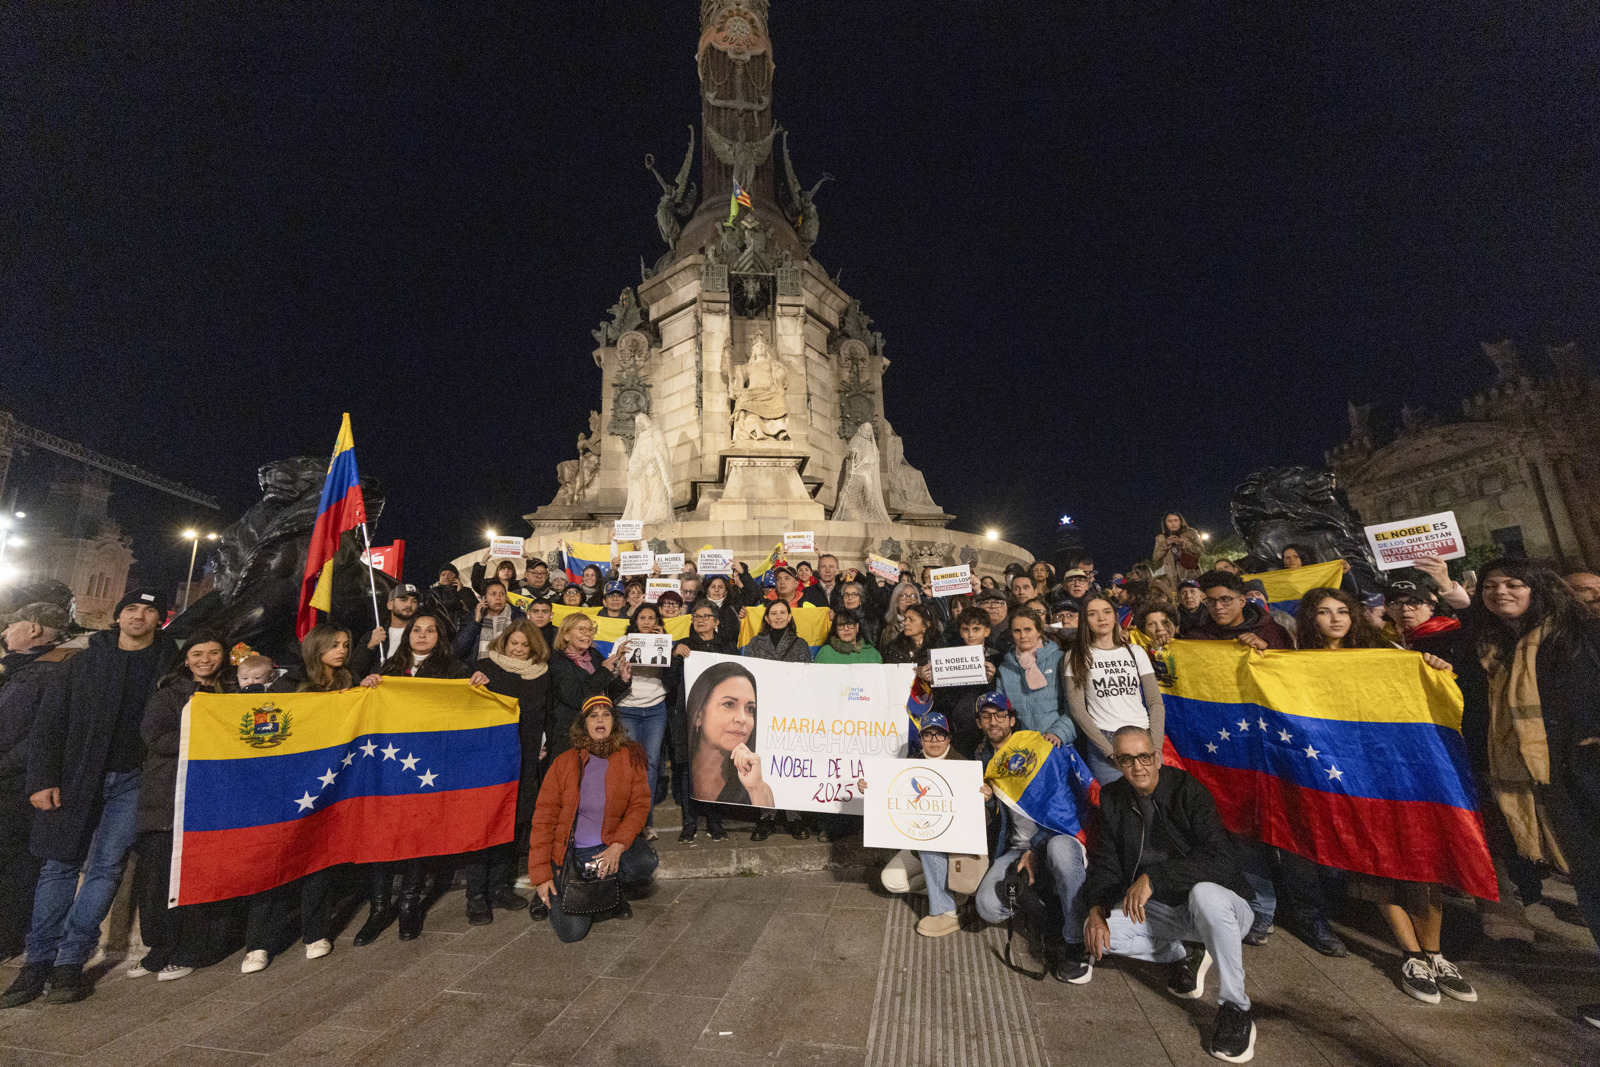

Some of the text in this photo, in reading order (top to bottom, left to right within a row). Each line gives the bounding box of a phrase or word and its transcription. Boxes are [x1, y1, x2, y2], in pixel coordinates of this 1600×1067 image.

[1391, 526, 1430, 538] NOBEL
[1433, 522, 1447, 531] ES
[1425, 531, 1452, 540] ESTÁN
[1381, 540, 1454, 556] INJUSTAMENTE
[1384, 550, 1438, 562] DETENIDOS
[1092, 673, 1138, 690] MARÍA
[772, 716, 898, 736] MARIA CORINA
[766, 726, 904, 756] MACHADO
[770, 755, 864, 778] NOBEL DE LA
[812, 782, 854, 803] 2025
[888, 798, 956, 813] EL NOBEL
